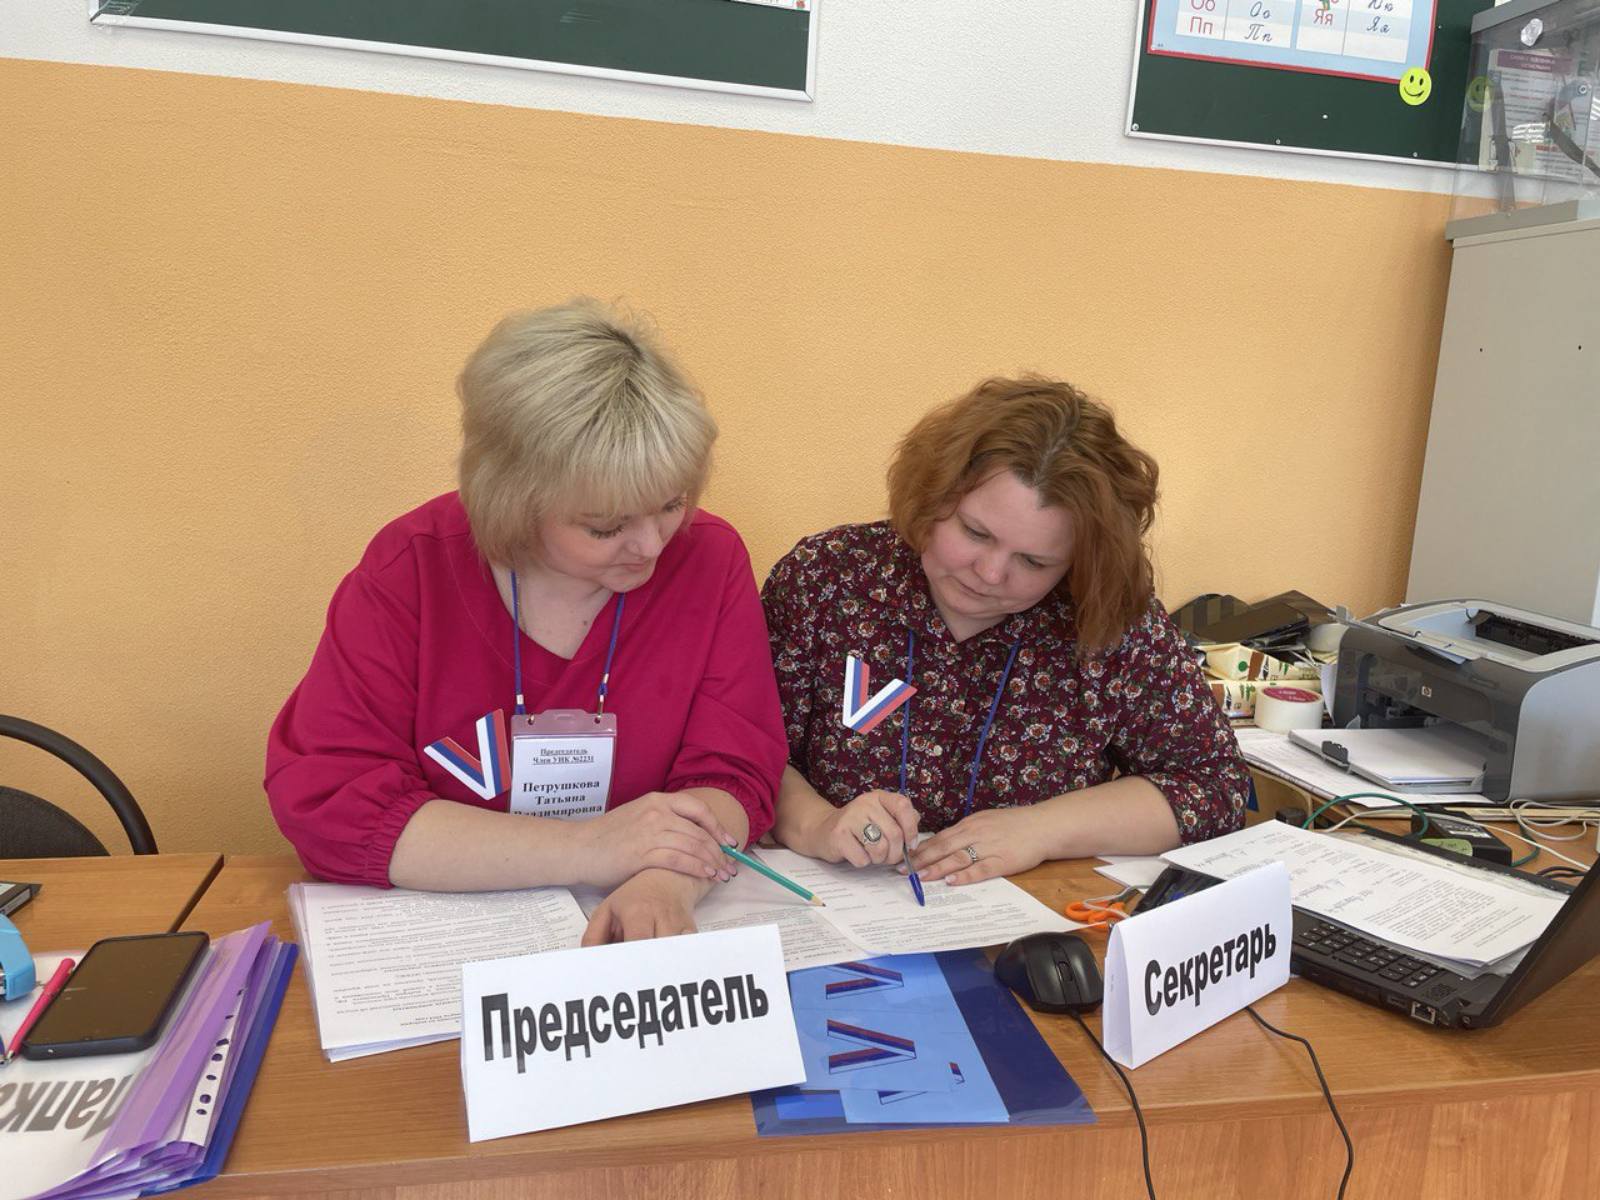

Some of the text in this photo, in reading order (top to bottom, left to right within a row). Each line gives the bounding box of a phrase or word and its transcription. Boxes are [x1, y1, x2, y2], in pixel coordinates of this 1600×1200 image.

[1190, 16, 1214, 35] Пп
[1313, 8, 1334, 25] Яя
[523, 781, 600, 794] Петрушкова
[534, 795, 586, 806] Татьяна
[1144, 923, 1277, 1017] Секретарь
[481, 973, 770, 1074] Председатель
